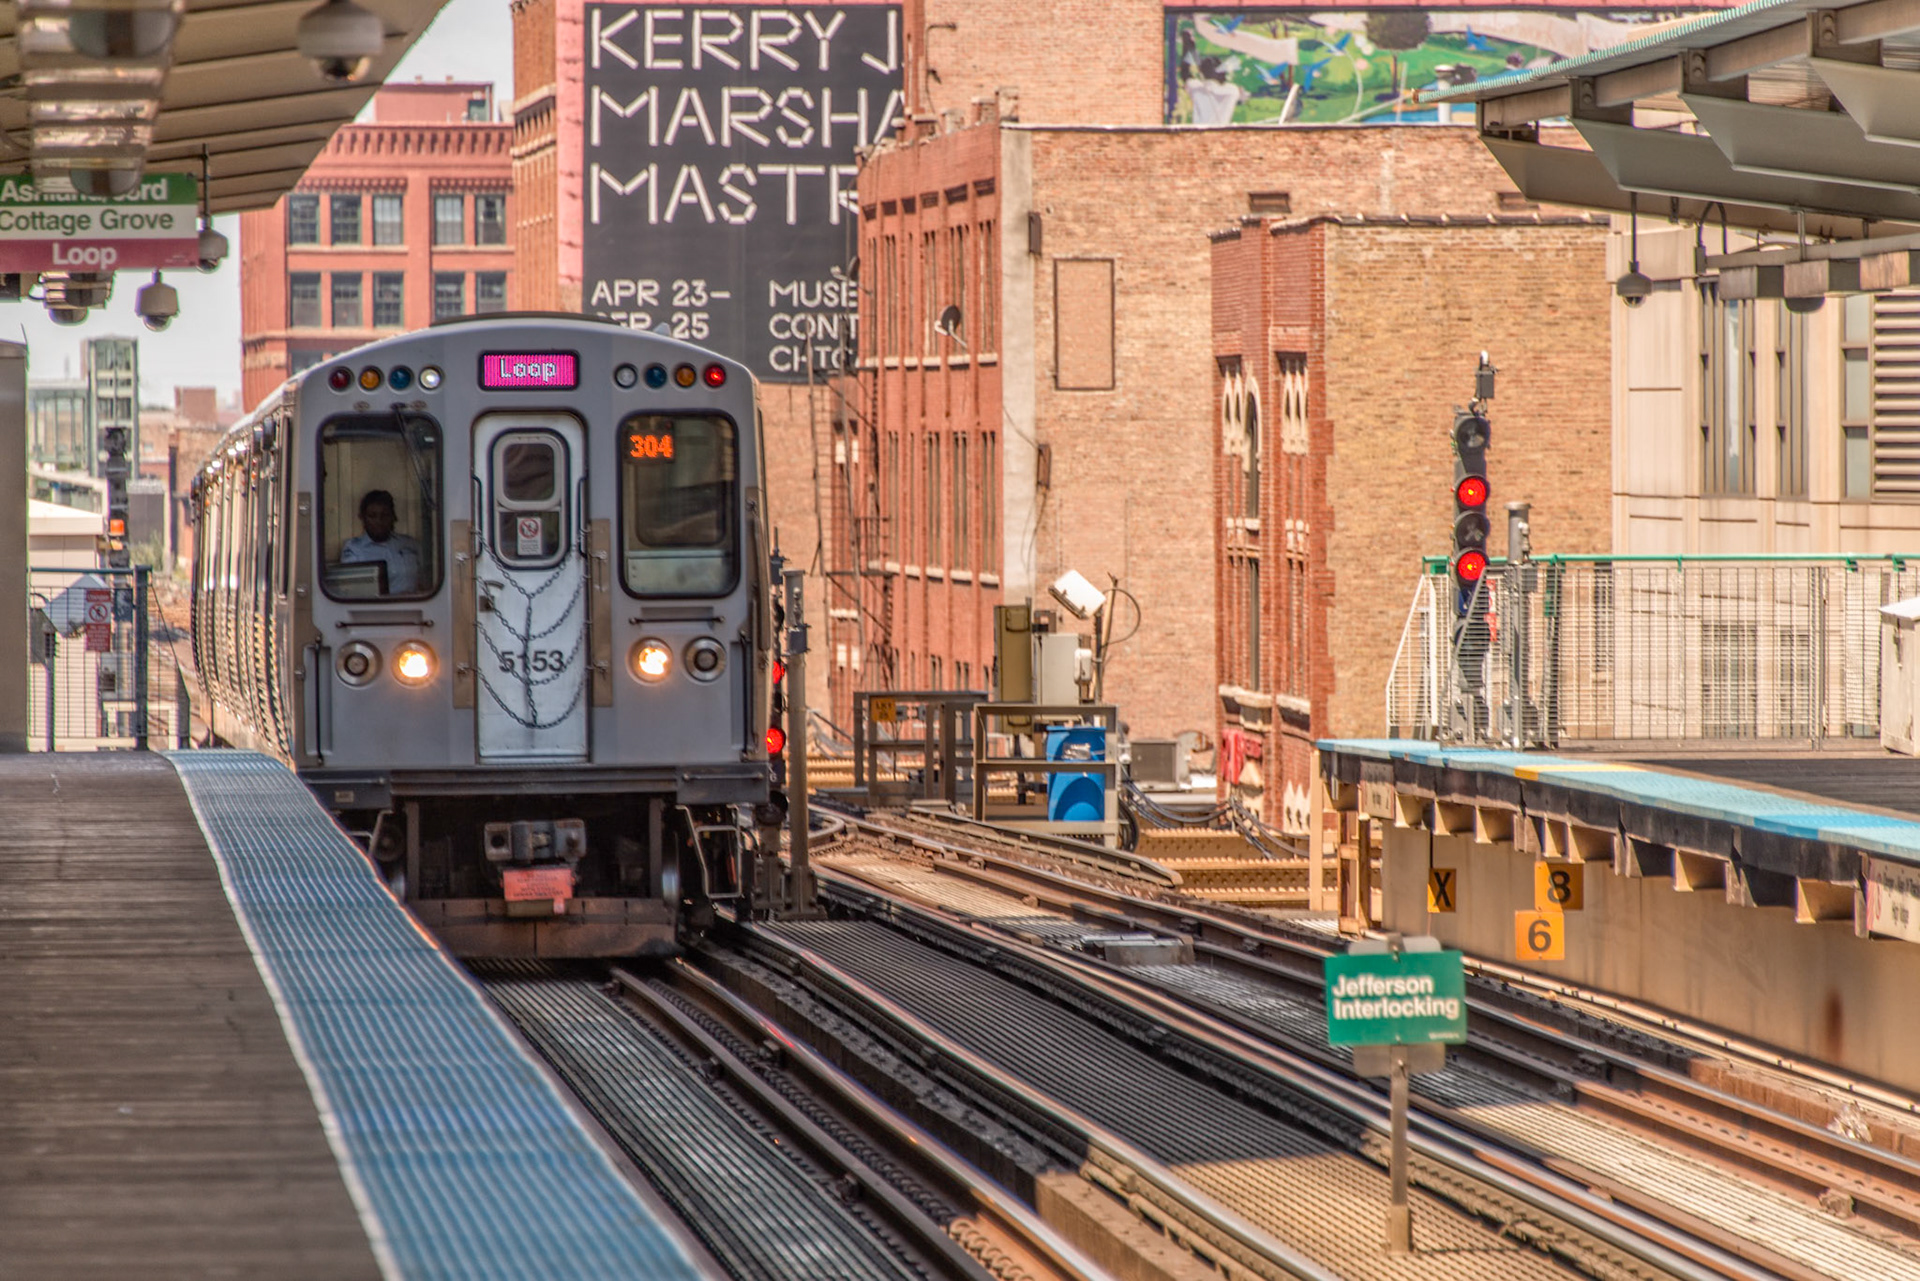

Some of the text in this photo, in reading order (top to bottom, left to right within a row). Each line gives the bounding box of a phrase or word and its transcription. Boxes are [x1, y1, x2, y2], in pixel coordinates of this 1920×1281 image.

[591, 8, 846, 71] KERRY
[0, 208, 174, 236] Cottage Grove
[52, 242, 117, 270] Loop
[590, 278, 660, 307] APR
[768, 279, 858, 308] MUSE
[671, 311, 710, 340] 25
[499, 358, 557, 382] Loop
[629, 434, 673, 459] 304
[1433, 871, 1452, 908] X
[1546, 870, 1572, 904] 8
[1527, 919, 1552, 953] 6
[1332, 974, 1435, 997] Jefferson
[1332, 996, 1461, 1021] Interlocking
